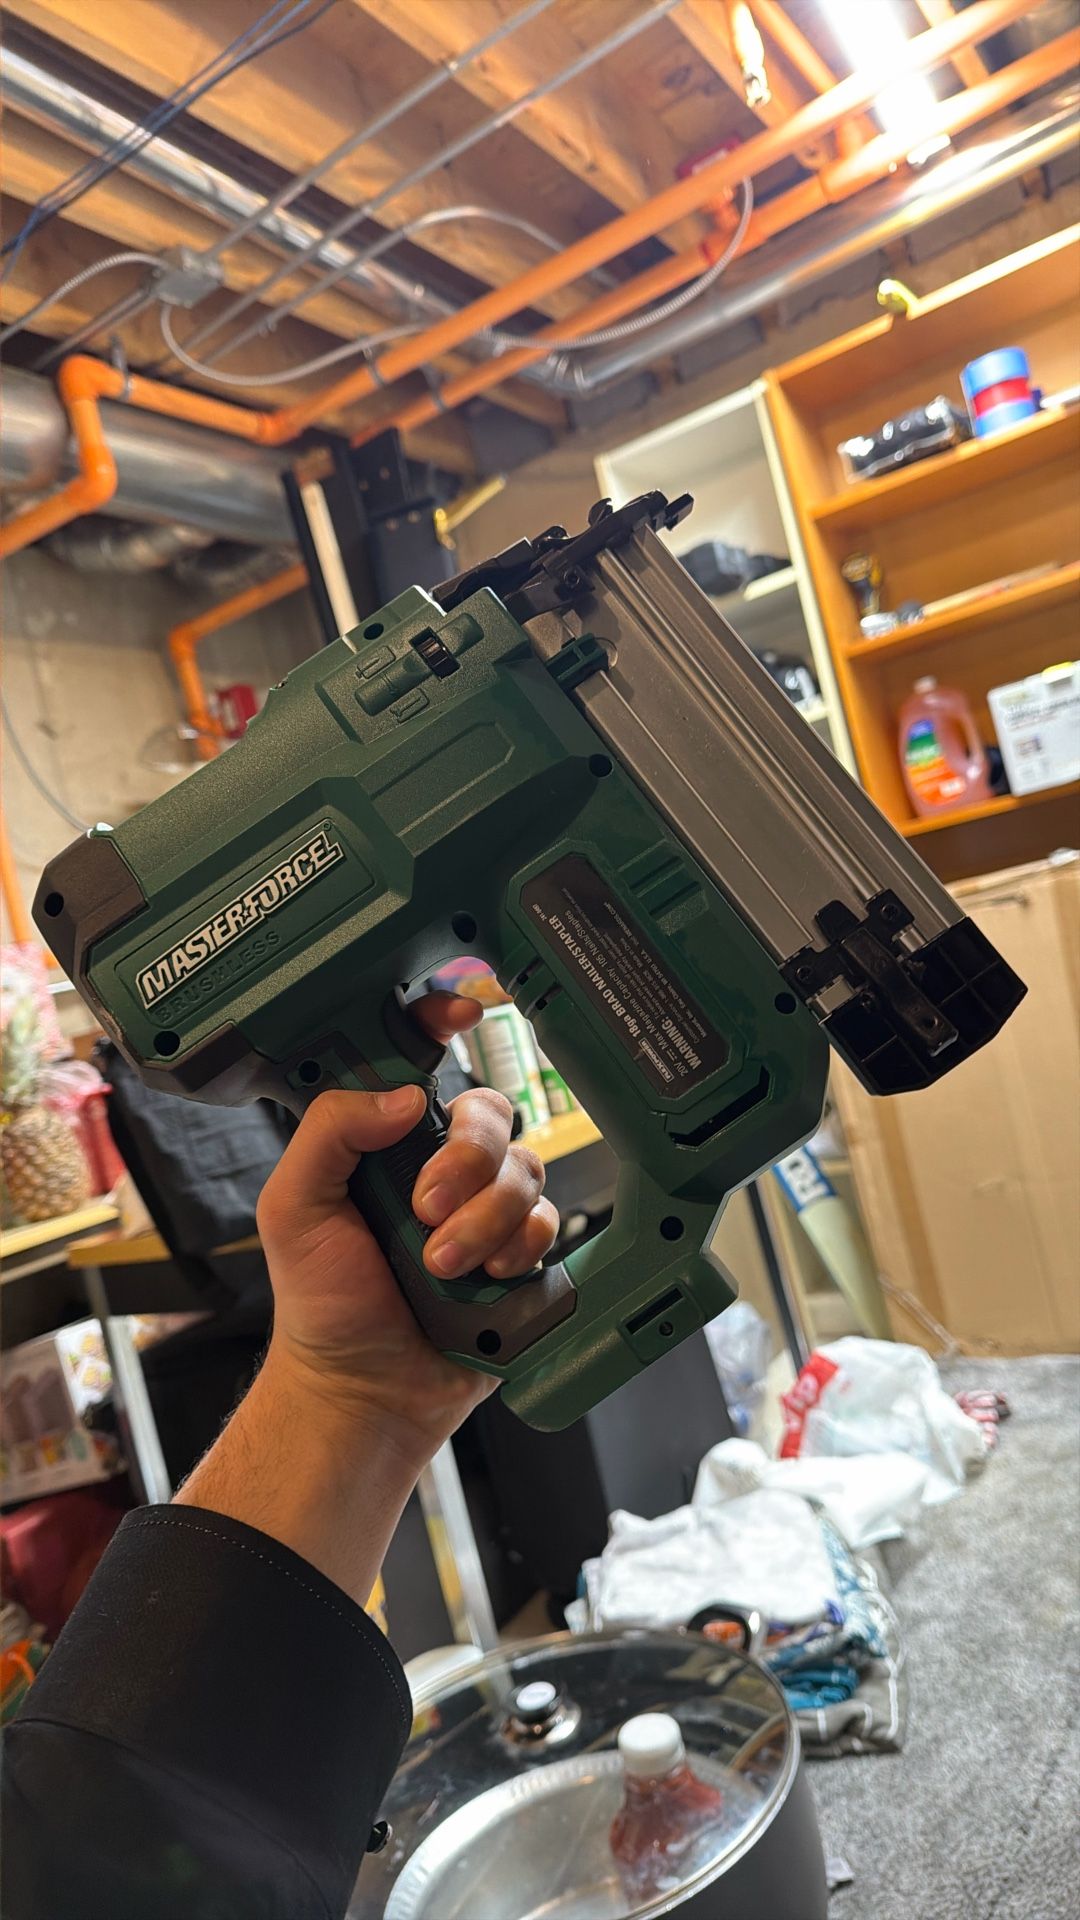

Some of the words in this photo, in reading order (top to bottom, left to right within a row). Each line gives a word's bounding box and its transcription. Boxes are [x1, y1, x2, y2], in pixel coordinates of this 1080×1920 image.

[139, 834, 342, 1004] MASTERFORCE
[562, 909, 600, 955] Nails/Staples
[546, 914, 608, 990] NAILER/STAPLER
[595, 953, 608, 967] 105
[155, 931, 281, 1023] BRUSHLESS
[601, 987, 626, 1016] BRAD
[627, 996, 658, 1034] Magazine
[620, 1012, 643, 1037] 18ga
[652, 1031, 669, 1050] Max
[657, 1015, 702, 1069] WARNING:
[640, 1040, 671, 1079] FLEXPOWER
[673, 1059, 689, 1077] 20V
